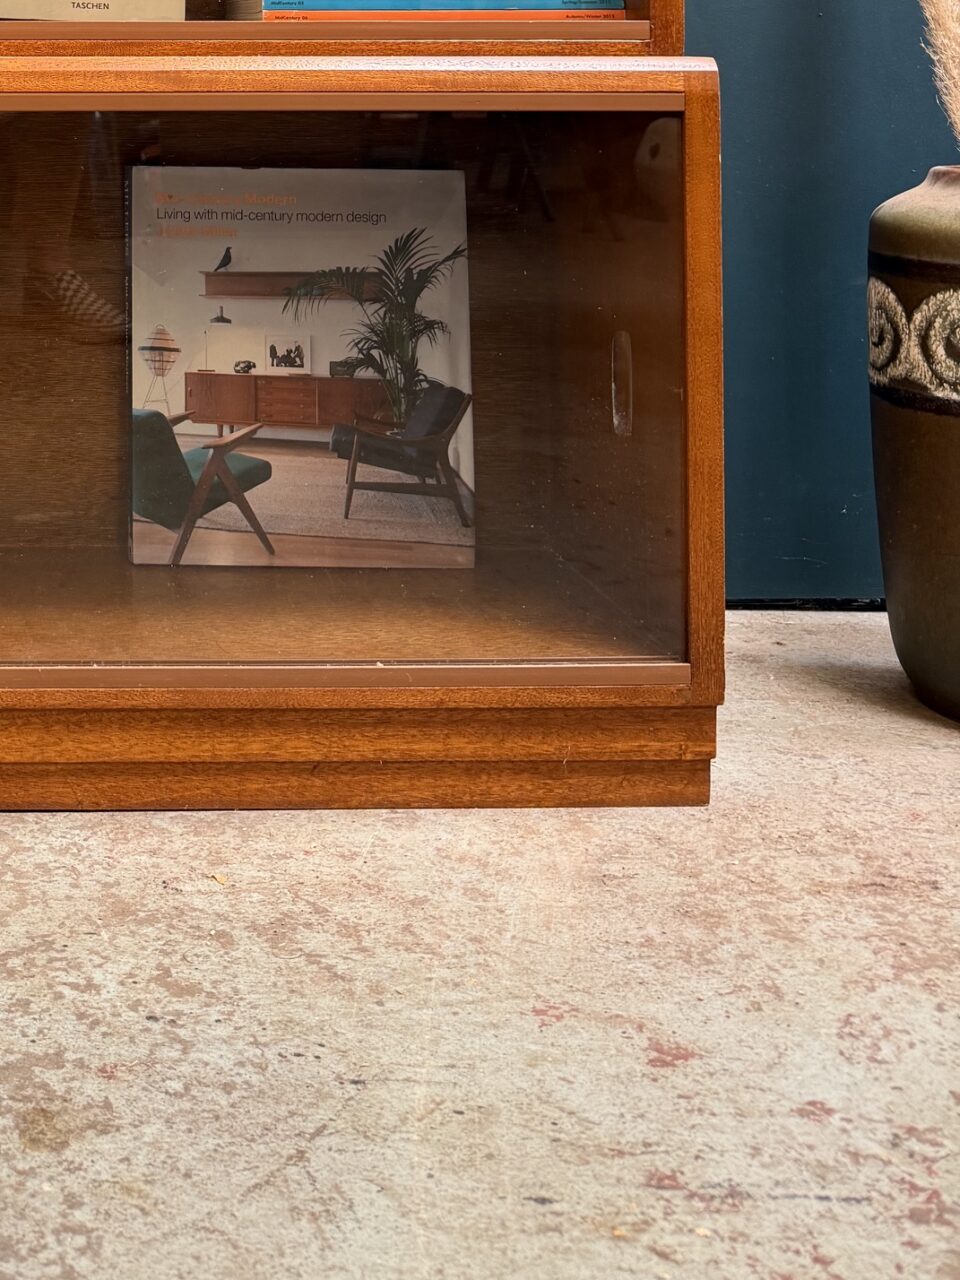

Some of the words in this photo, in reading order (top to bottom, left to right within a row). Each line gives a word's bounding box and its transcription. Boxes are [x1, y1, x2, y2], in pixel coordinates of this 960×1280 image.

[71, 2, 110, 10] TASCHEN
[156, 208, 190, 223] Living
[193, 208, 218, 221] with
[221, 208, 293, 224] mid-century
[296, 210, 343, 223] modern
[346, 211, 387, 225] design
